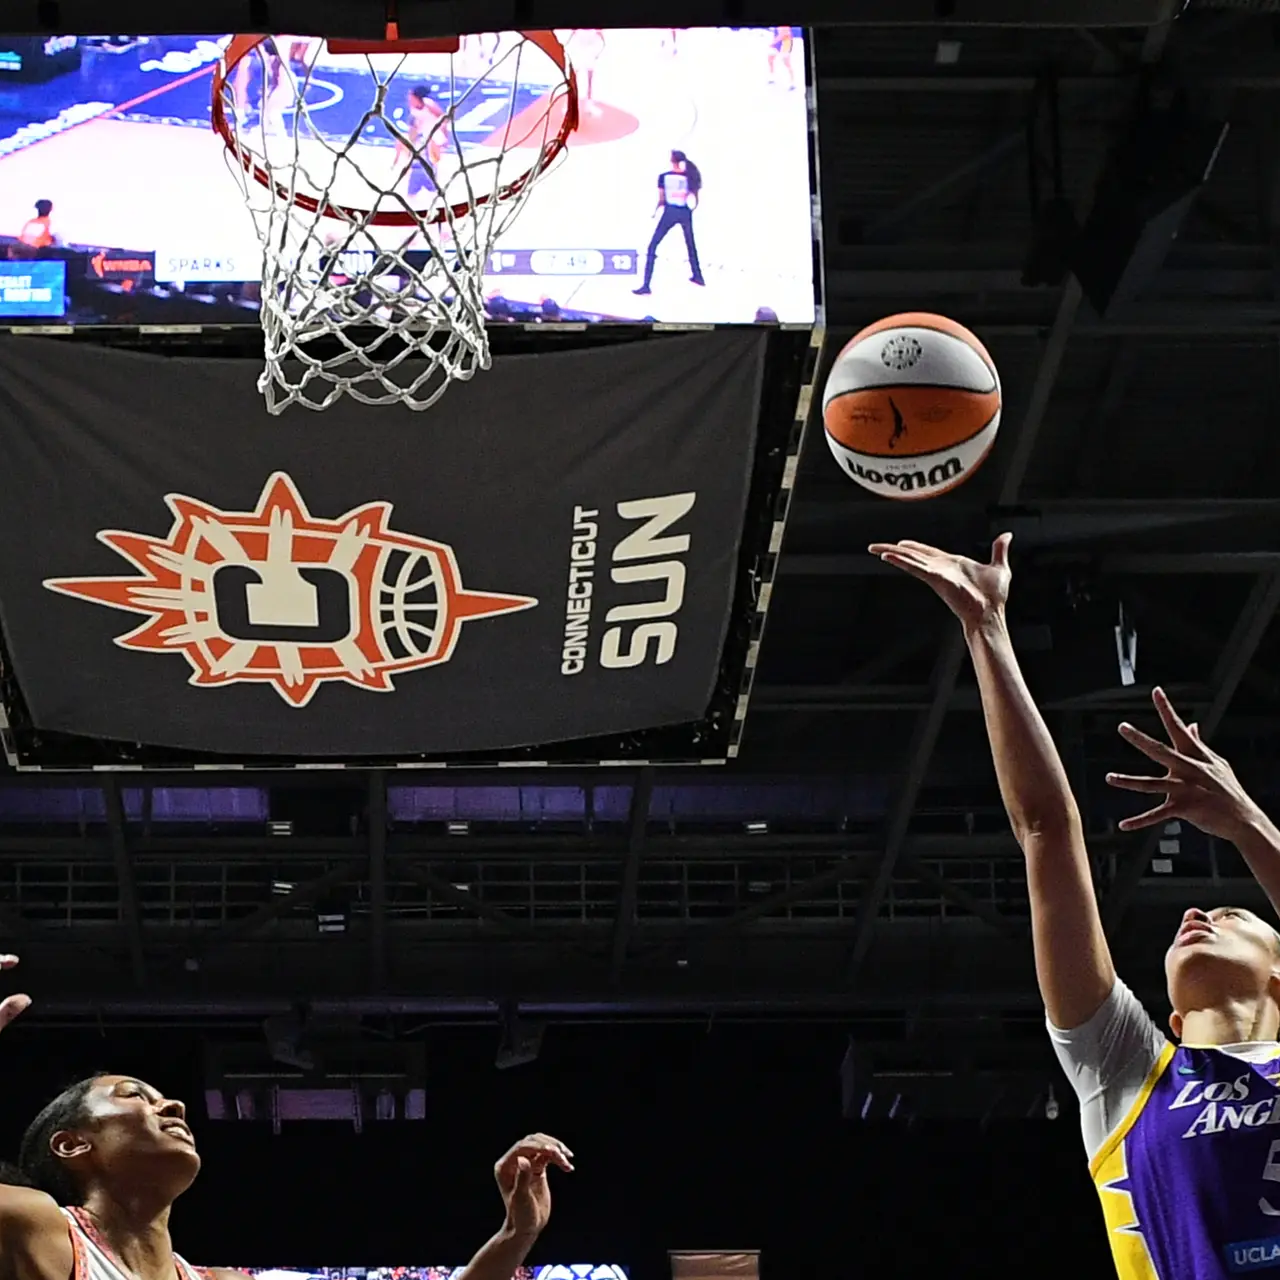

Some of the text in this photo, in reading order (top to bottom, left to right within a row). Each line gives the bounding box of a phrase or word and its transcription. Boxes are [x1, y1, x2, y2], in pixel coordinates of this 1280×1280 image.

[845, 456, 964, 492] Wilson
[561, 505, 599, 675] CONNECTICUT
[600, 491, 696, 669] SUN
